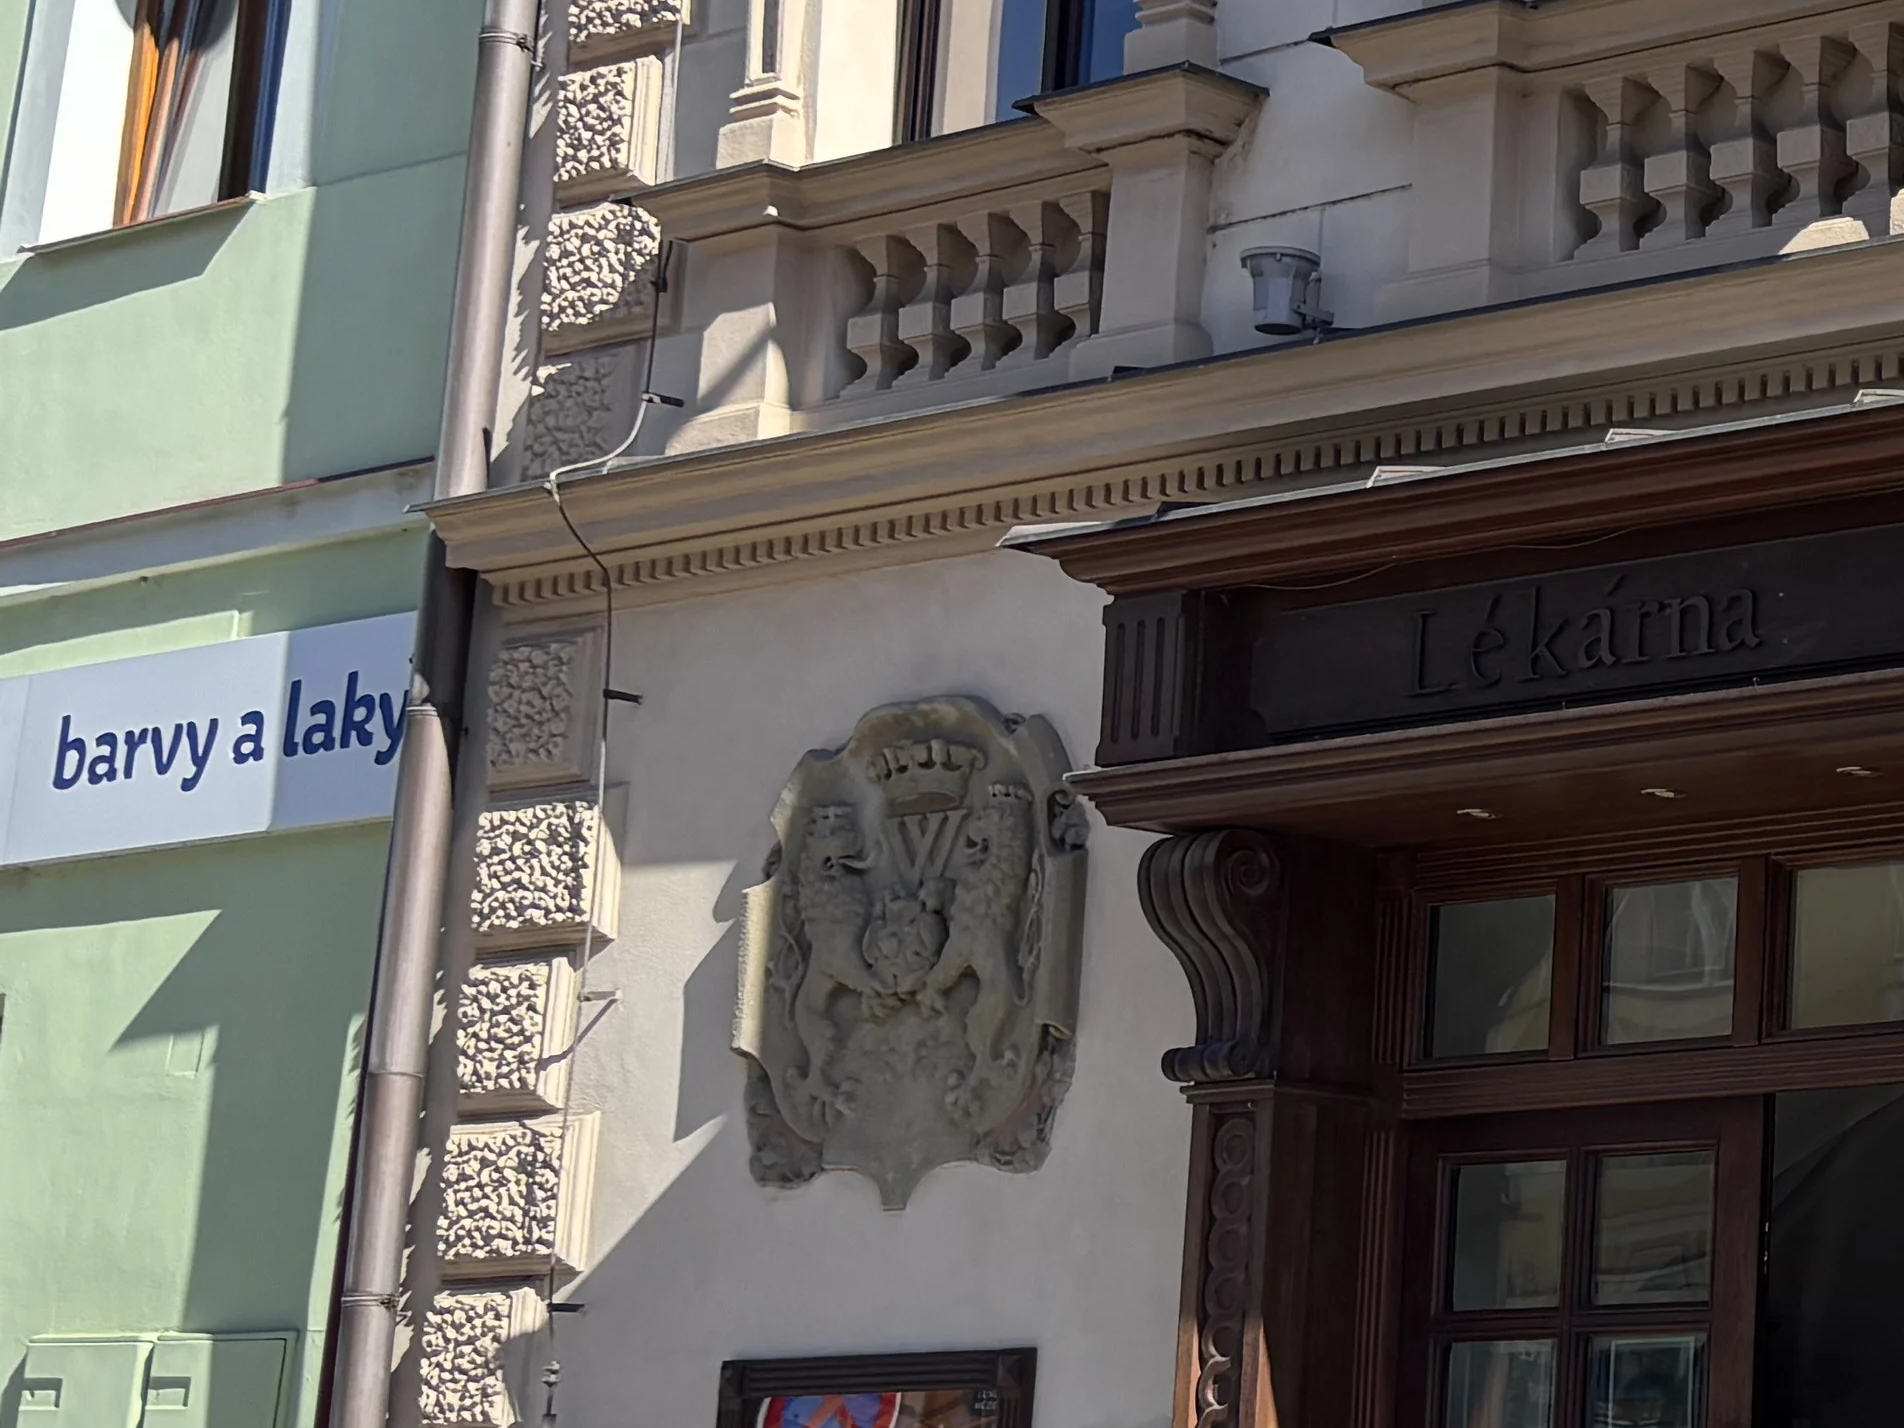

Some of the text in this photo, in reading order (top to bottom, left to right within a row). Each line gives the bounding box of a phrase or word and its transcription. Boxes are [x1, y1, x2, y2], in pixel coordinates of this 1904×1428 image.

[1404, 573, 1769, 698] Lékárna
[52, 669, 410, 792] barvy a laky
